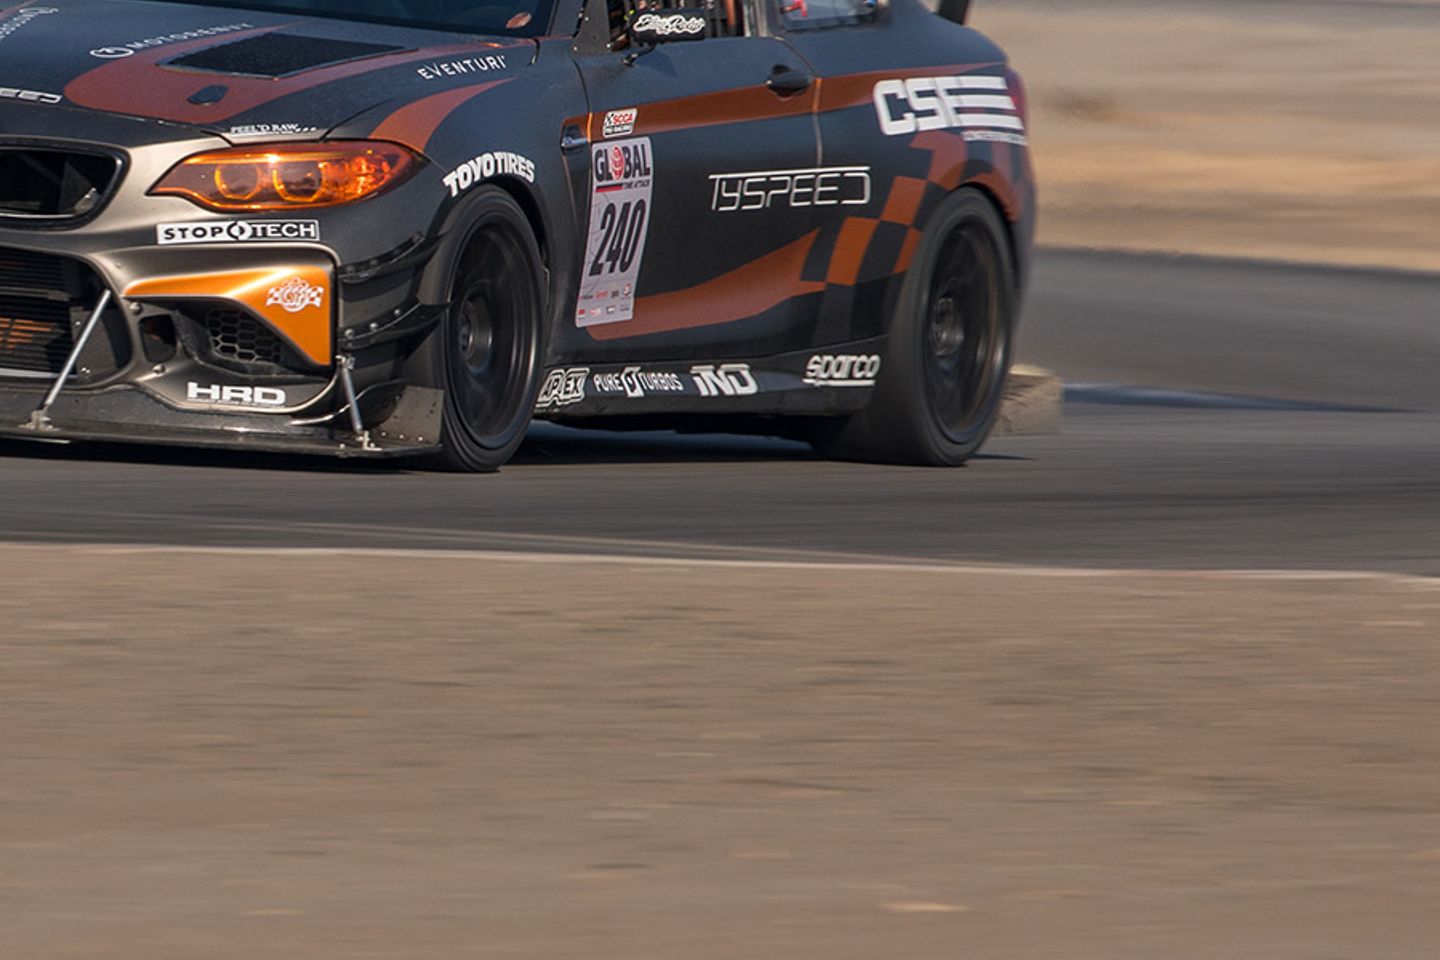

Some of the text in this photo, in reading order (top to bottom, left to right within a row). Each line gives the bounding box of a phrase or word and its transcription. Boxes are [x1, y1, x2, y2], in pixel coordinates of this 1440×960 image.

[417, 55, 506, 80] EVENTURI
[442, 151, 536, 197] TOYO TIRES
[594, 143, 651, 182] GLOBAL
[164, 223, 315, 240] STOP TECH
[589, 198, 646, 277] 240
[806, 354, 880, 380] sparco
[187, 382, 286, 405] HRD
[537, 369, 588, 404] APEX
[593, 373, 624, 392] PURE
[638, 372, 684, 391] TURBOS
